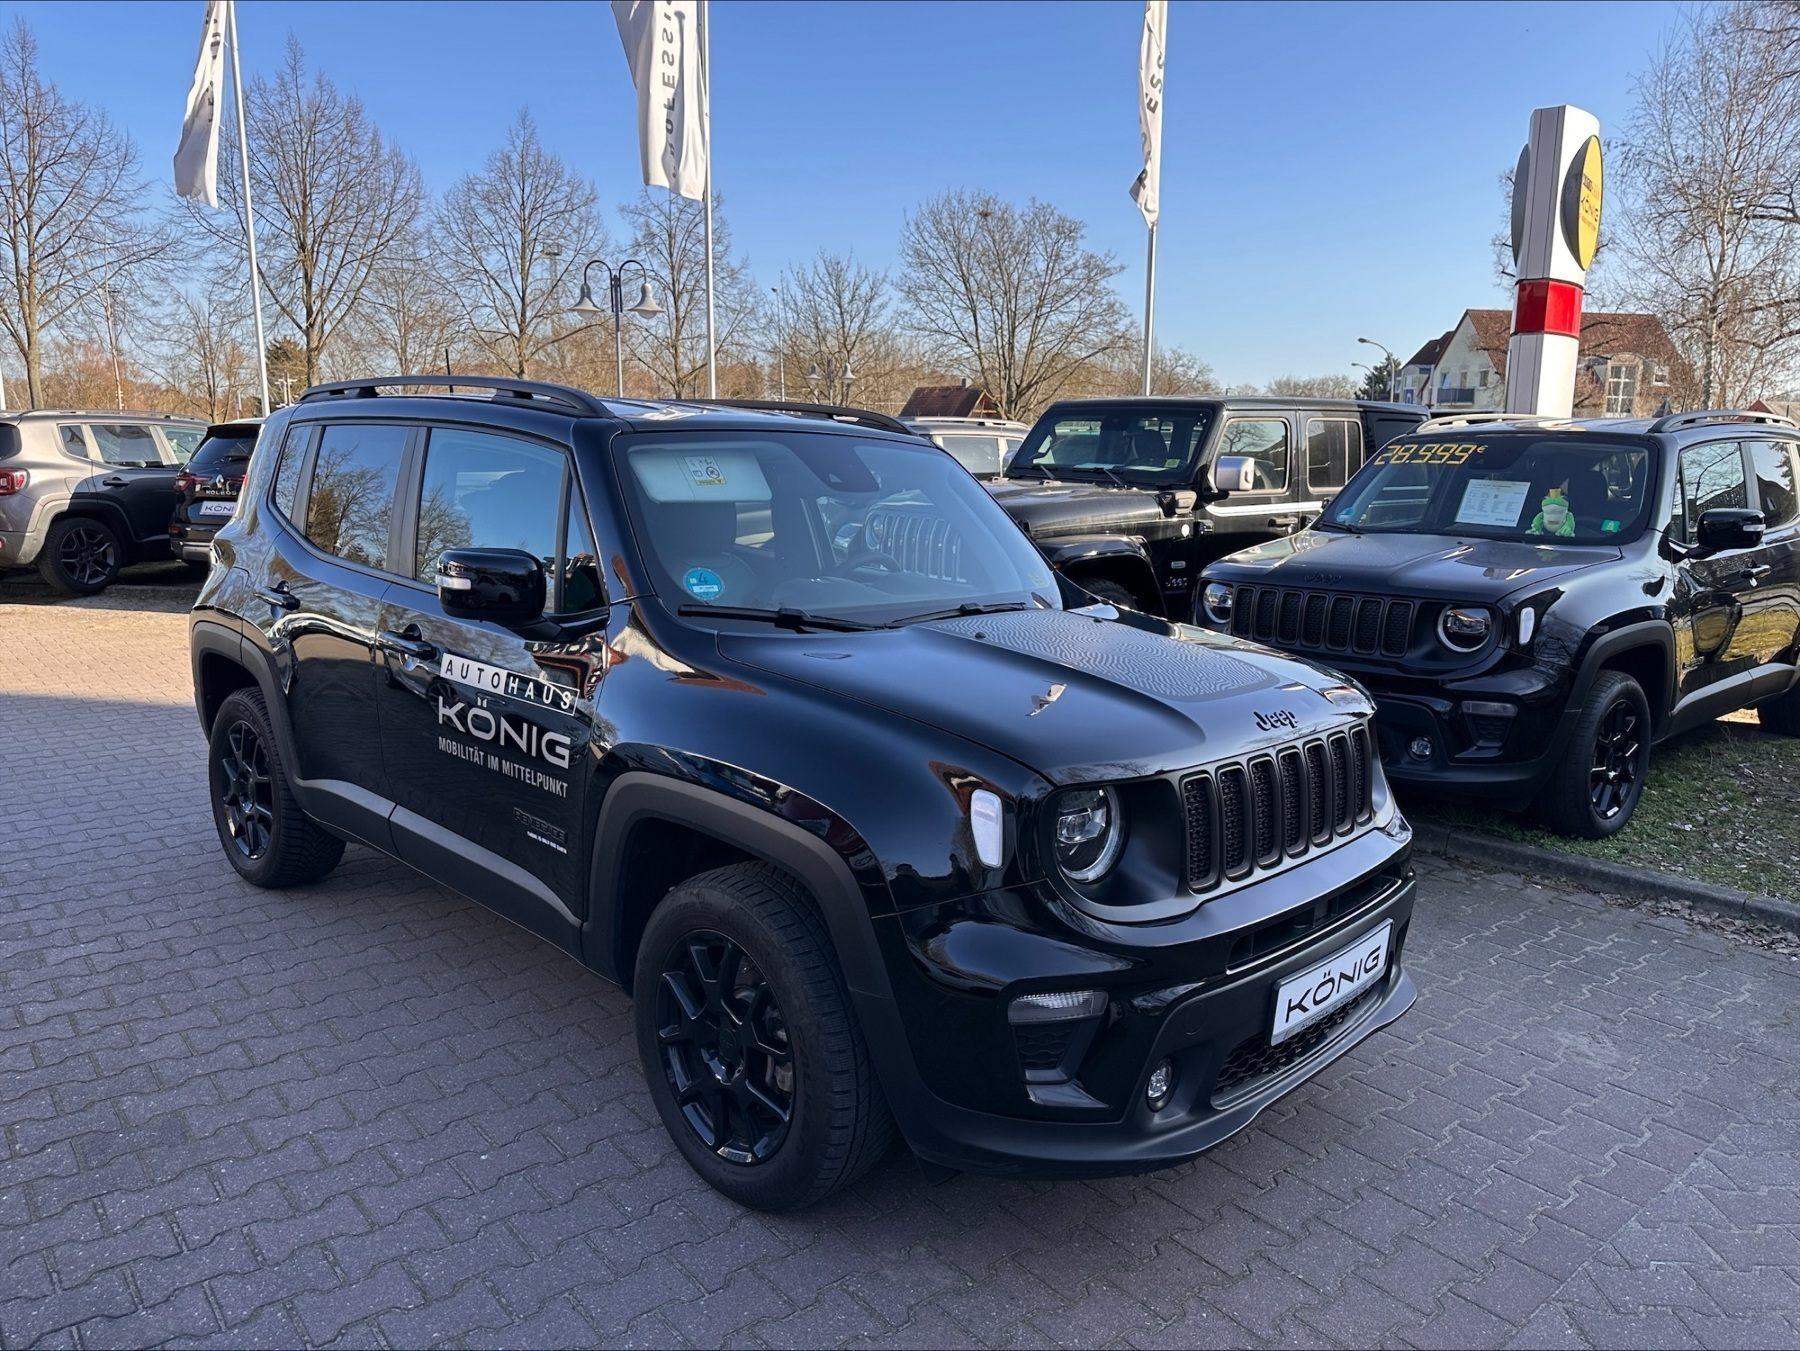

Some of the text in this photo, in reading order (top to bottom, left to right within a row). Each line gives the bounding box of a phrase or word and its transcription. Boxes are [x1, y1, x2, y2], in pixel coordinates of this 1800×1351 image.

[204, 504, 235, 513] KÖNI
[445, 659, 574, 710] AUTOHAUS
[438, 695, 571, 769] KÖNIG
[1253, 710, 1299, 731] Jeep
[438, 736, 569, 799] MOBILITÄT IM MITTELPUNKT
[1285, 945, 1382, 1023] KÖNIG
